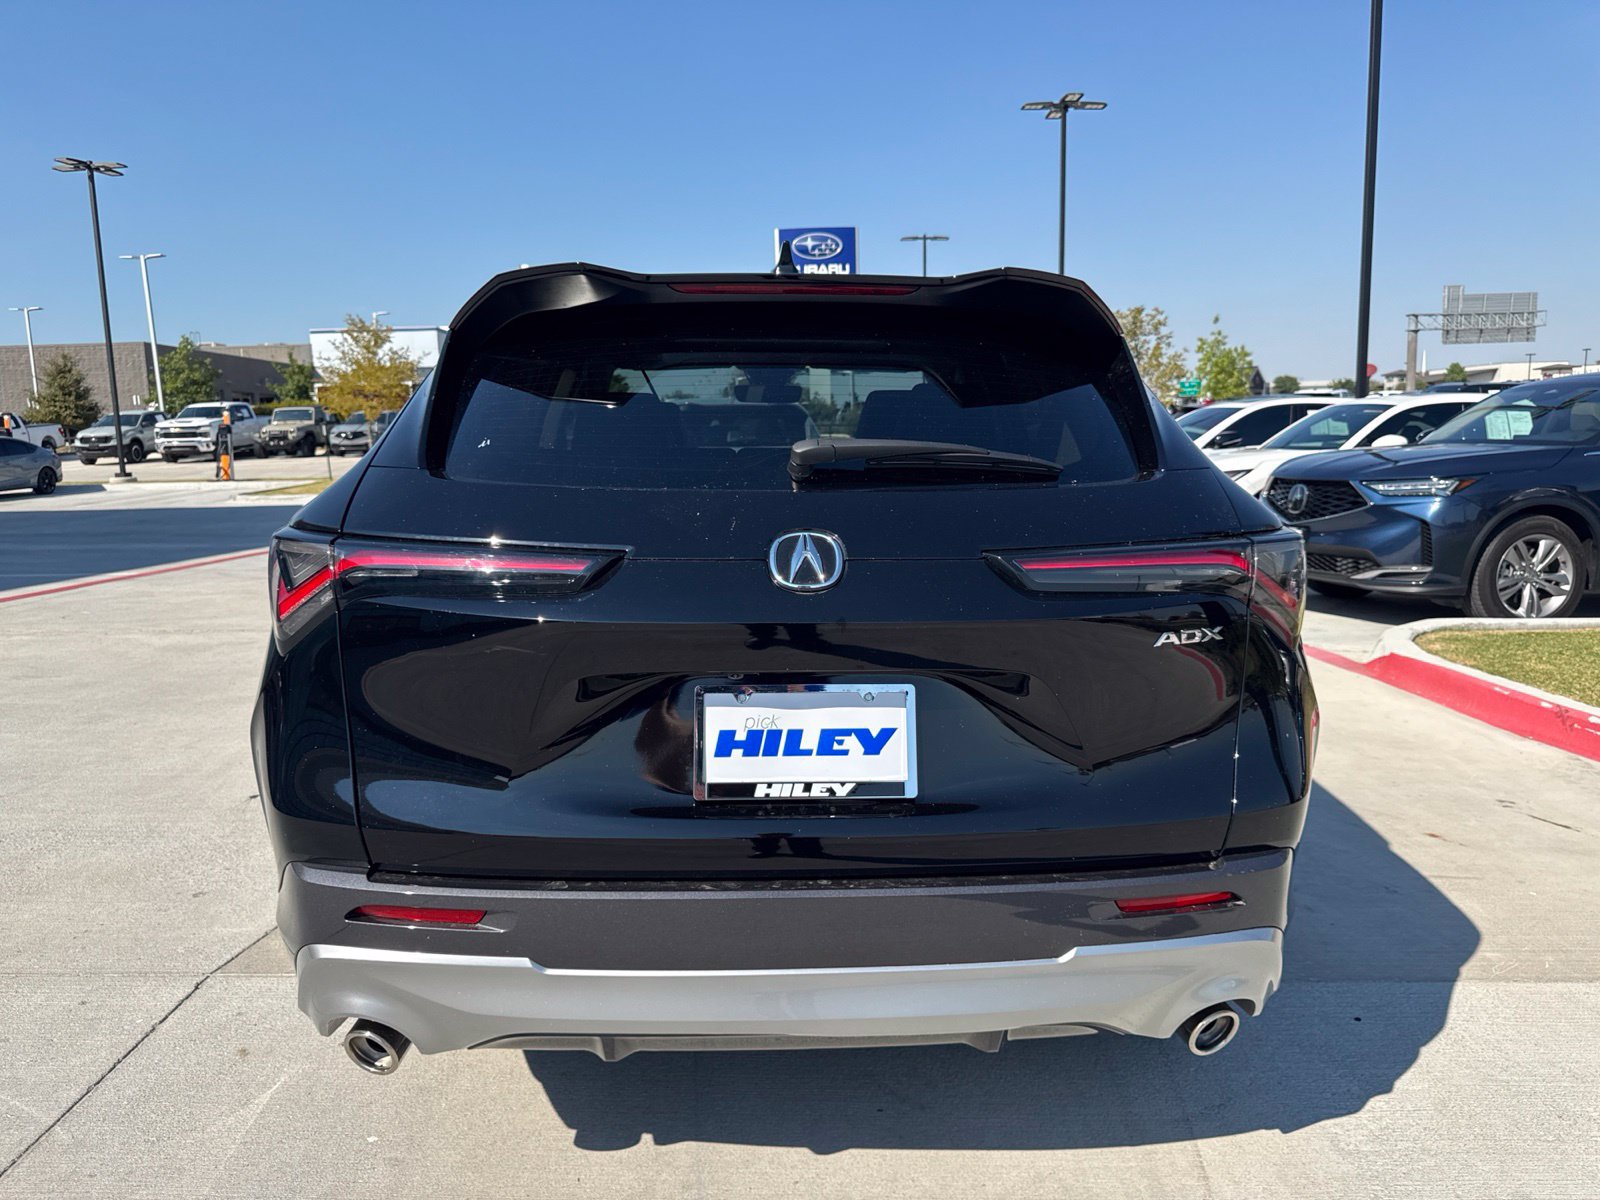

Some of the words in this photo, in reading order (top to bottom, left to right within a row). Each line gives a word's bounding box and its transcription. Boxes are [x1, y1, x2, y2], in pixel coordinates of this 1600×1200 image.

[795, 263, 850, 274] UBARU
[1153, 626, 1224, 647] ADX
[743, 714, 782, 732] pick
[713, 727, 898, 758] HILEY
[753, 782, 857, 798] HILEY
